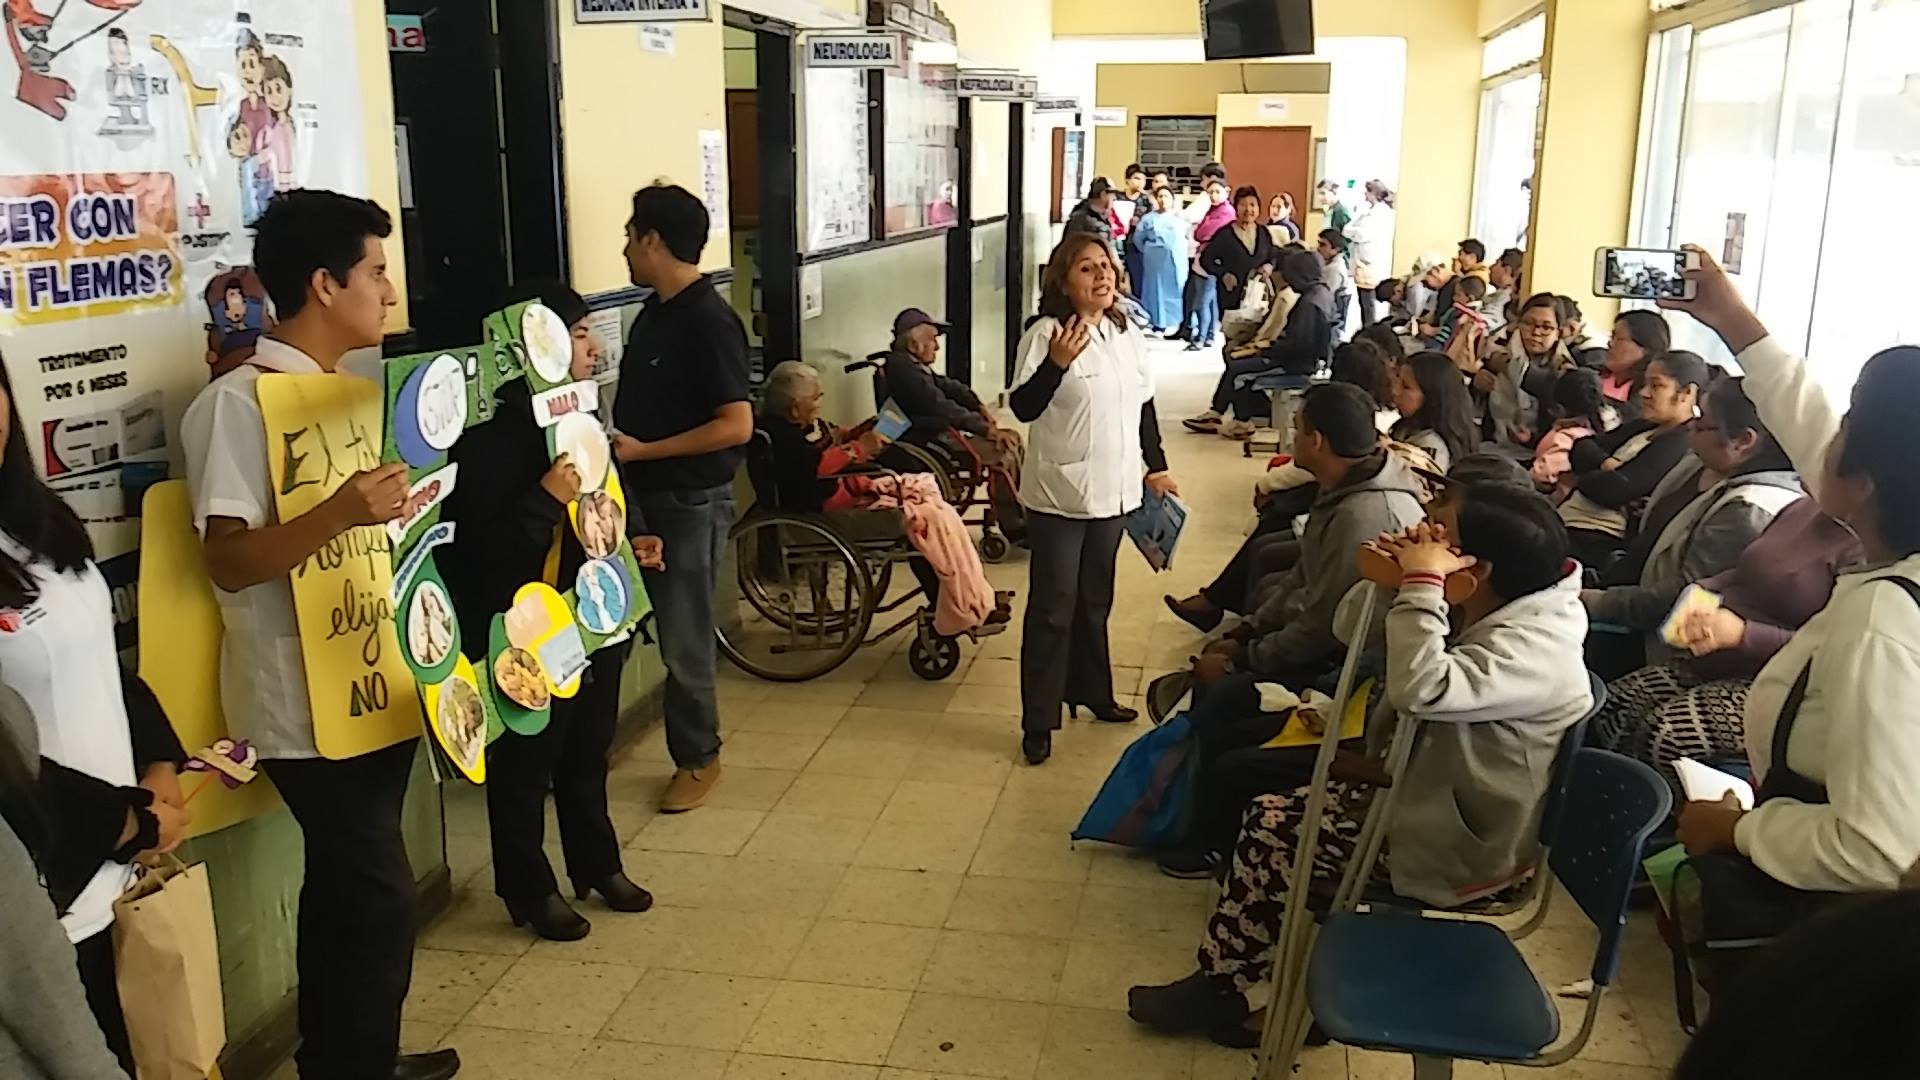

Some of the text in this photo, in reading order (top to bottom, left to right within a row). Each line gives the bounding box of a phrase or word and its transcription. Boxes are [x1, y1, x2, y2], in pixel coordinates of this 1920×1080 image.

[813, 42, 892, 59] NEUROLOGIA
[71, 197, 136, 241] CON
[27, 254, 173, 307] FLEMAS?
[44, 382, 72, 402] POR
[77, 379, 85, 395] 6
[326, 578, 397, 667] elija
[349, 671, 389, 717] NO
